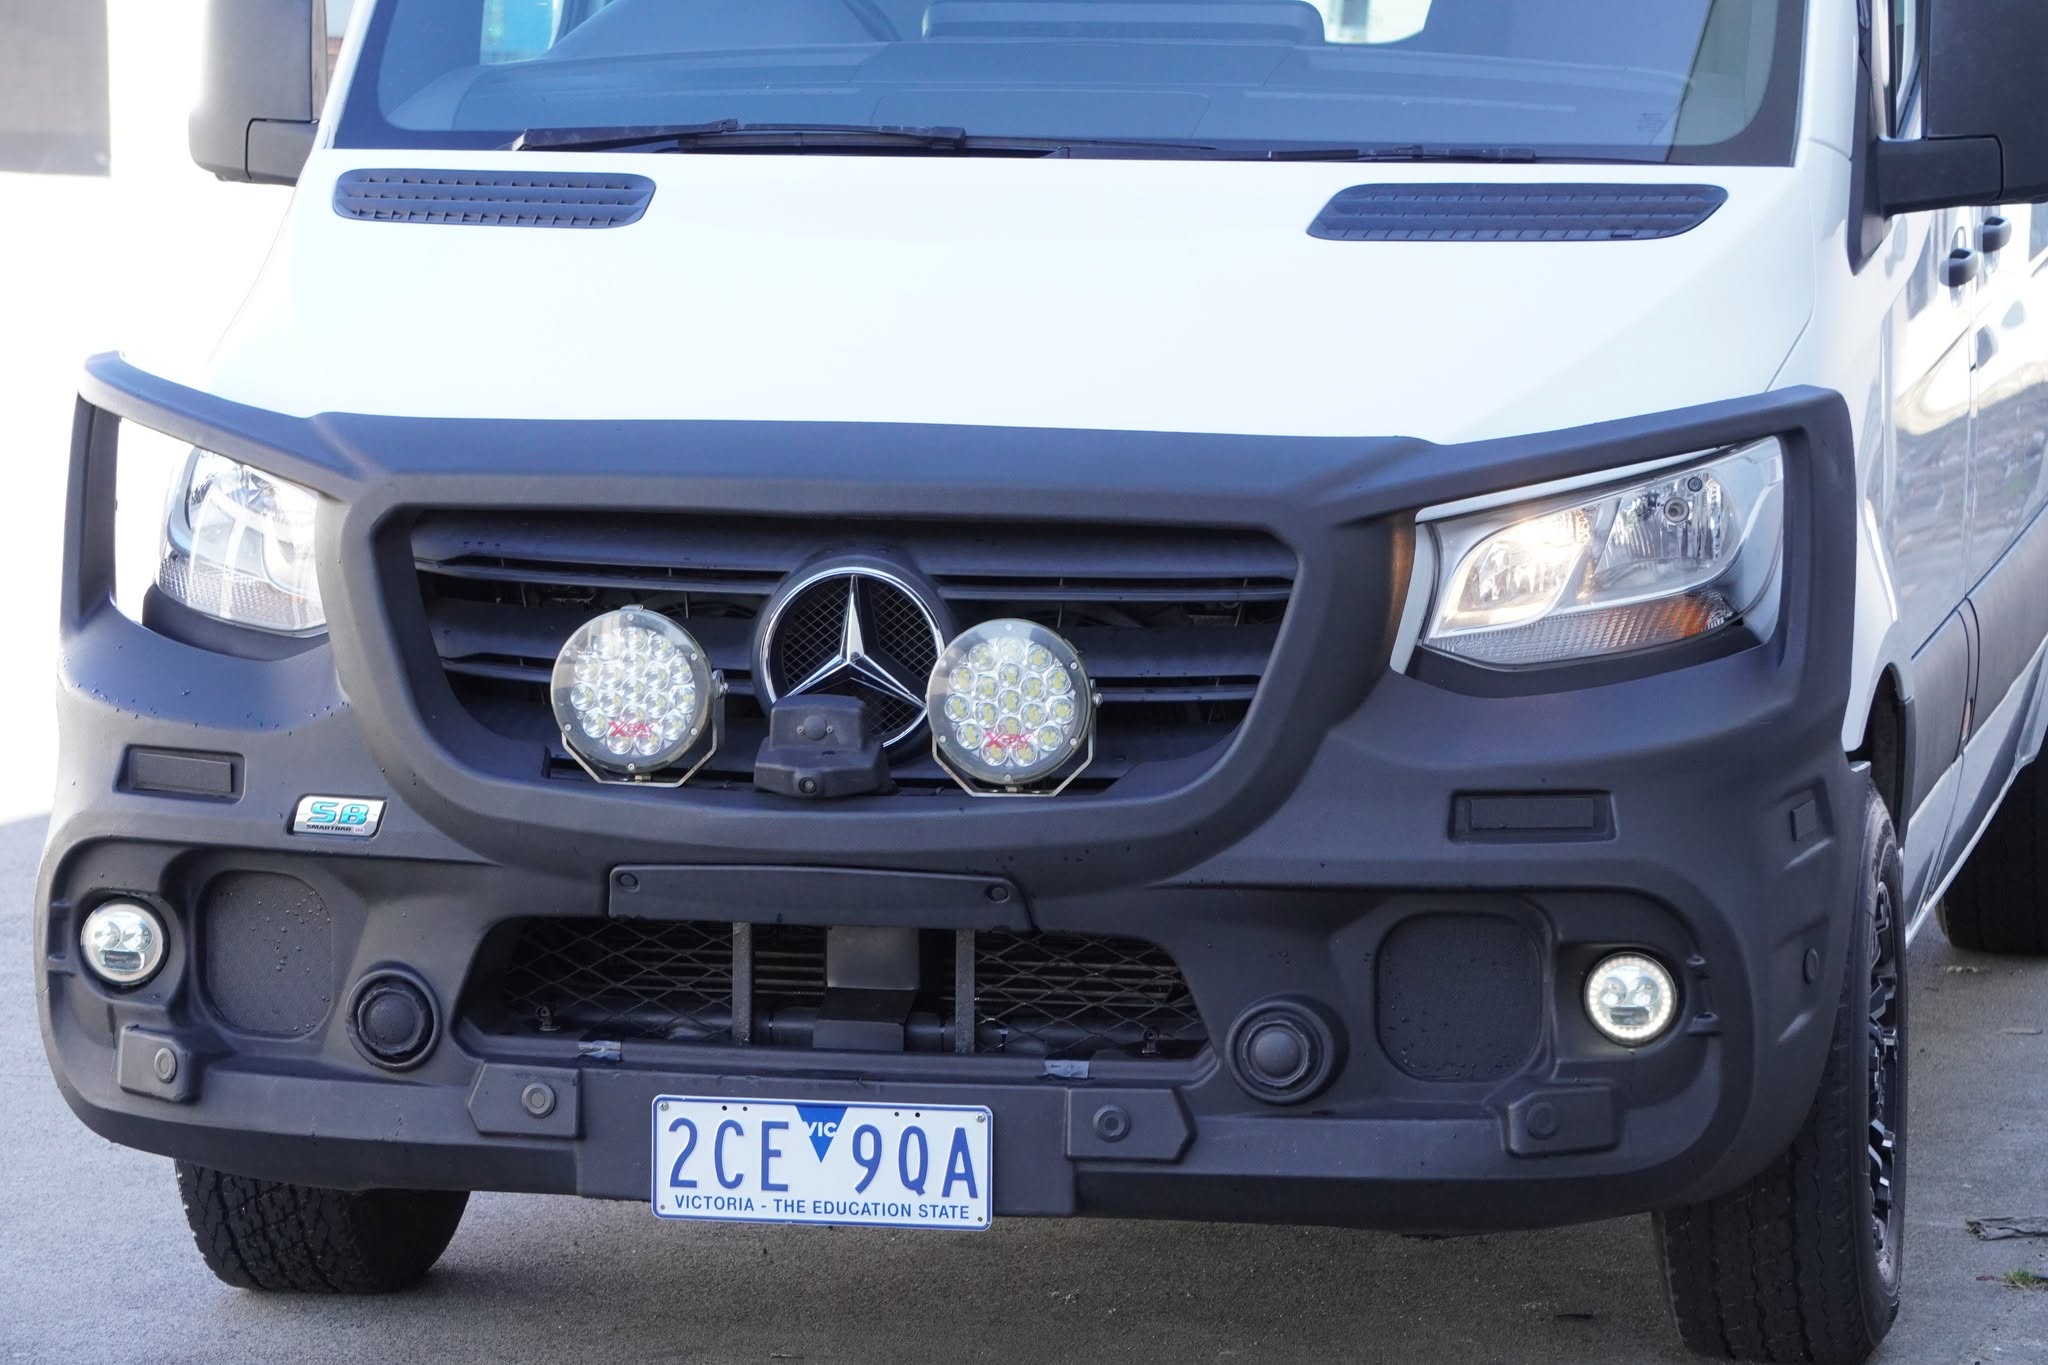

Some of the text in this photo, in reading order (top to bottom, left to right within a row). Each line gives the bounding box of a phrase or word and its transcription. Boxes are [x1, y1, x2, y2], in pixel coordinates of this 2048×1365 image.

[307, 802, 369, 825] SB
[808, 1121, 837, 1137] VIC
[668, 1117, 978, 1199] 2CE 9QA
[675, 1195, 754, 1211] VICTORIA
[773, 1199, 806, 1214] THE
[813, 1200, 911, 1217] EDUCATION
[918, 1204, 969, 1219] STATE
